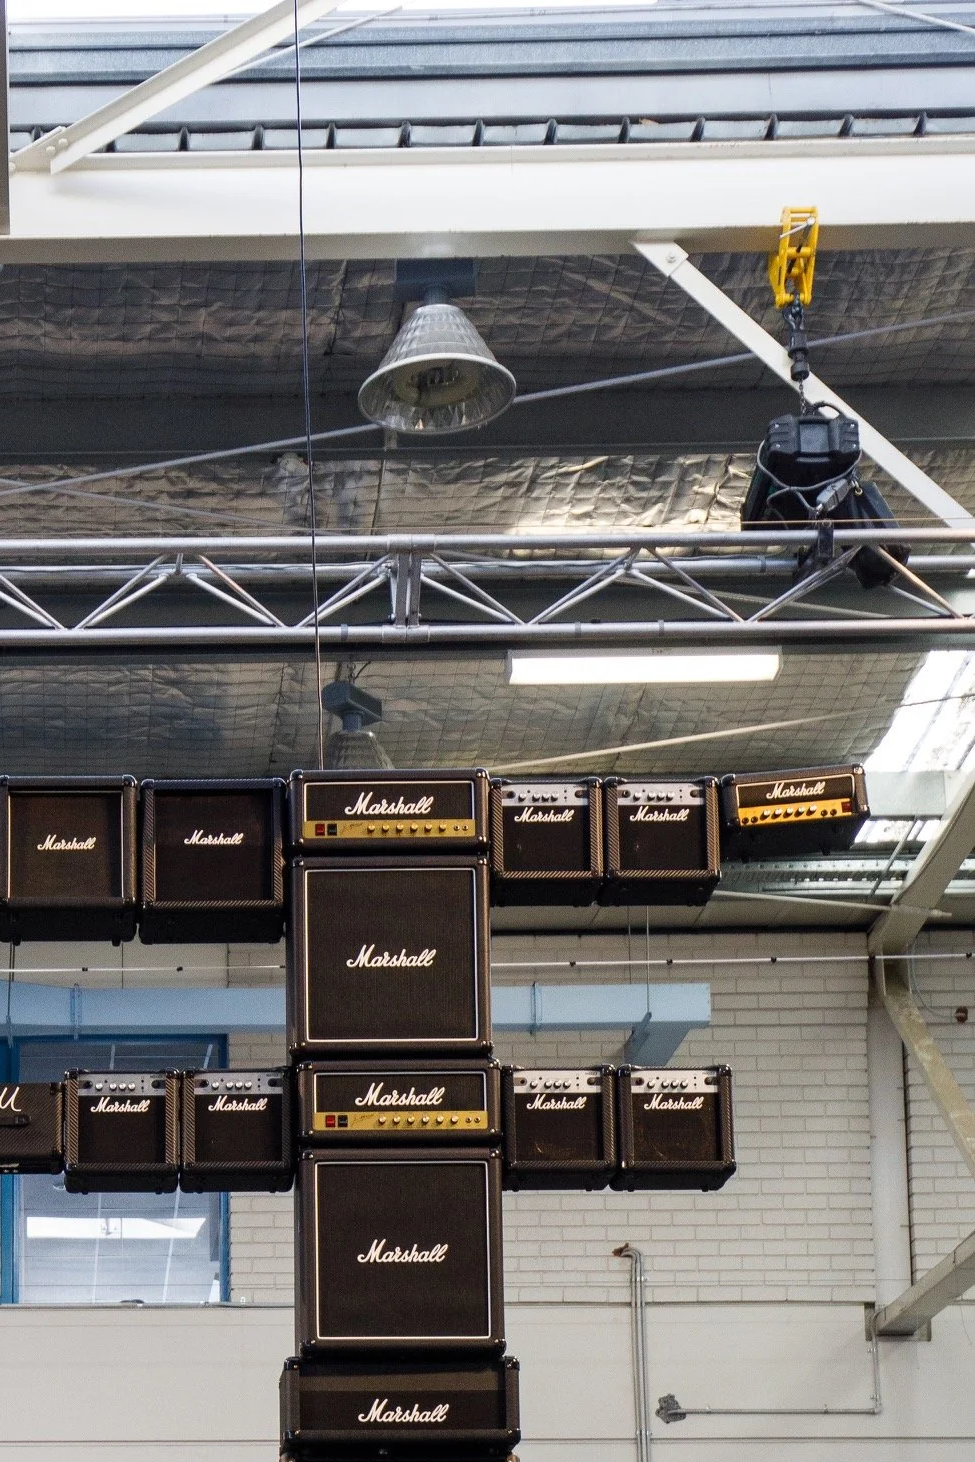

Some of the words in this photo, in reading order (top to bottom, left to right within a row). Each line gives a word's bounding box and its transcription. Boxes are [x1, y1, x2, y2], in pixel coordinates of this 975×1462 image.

[765, 781, 827, 800] Marshall
[344, 791, 434, 815] Marshall
[513, 806, 575, 823] Marshall
[629, 805, 690, 822] Marshall
[36, 834, 97, 851] Marshall
[183, 829, 244, 845] Marshall
[346, 943, 437, 968] Marshall
[354, 1081, 446, 1106] Marshall
[526, 1093, 587, 1110] Marshall
[643, 1093, 705, 1110] Marshall
[90, 1096, 151, 1113] Marshall
[207, 1094, 268, 1112] Marshall
[356, 1238, 449, 1263] Marshall
[357, 1398, 450, 1423] Marshall
